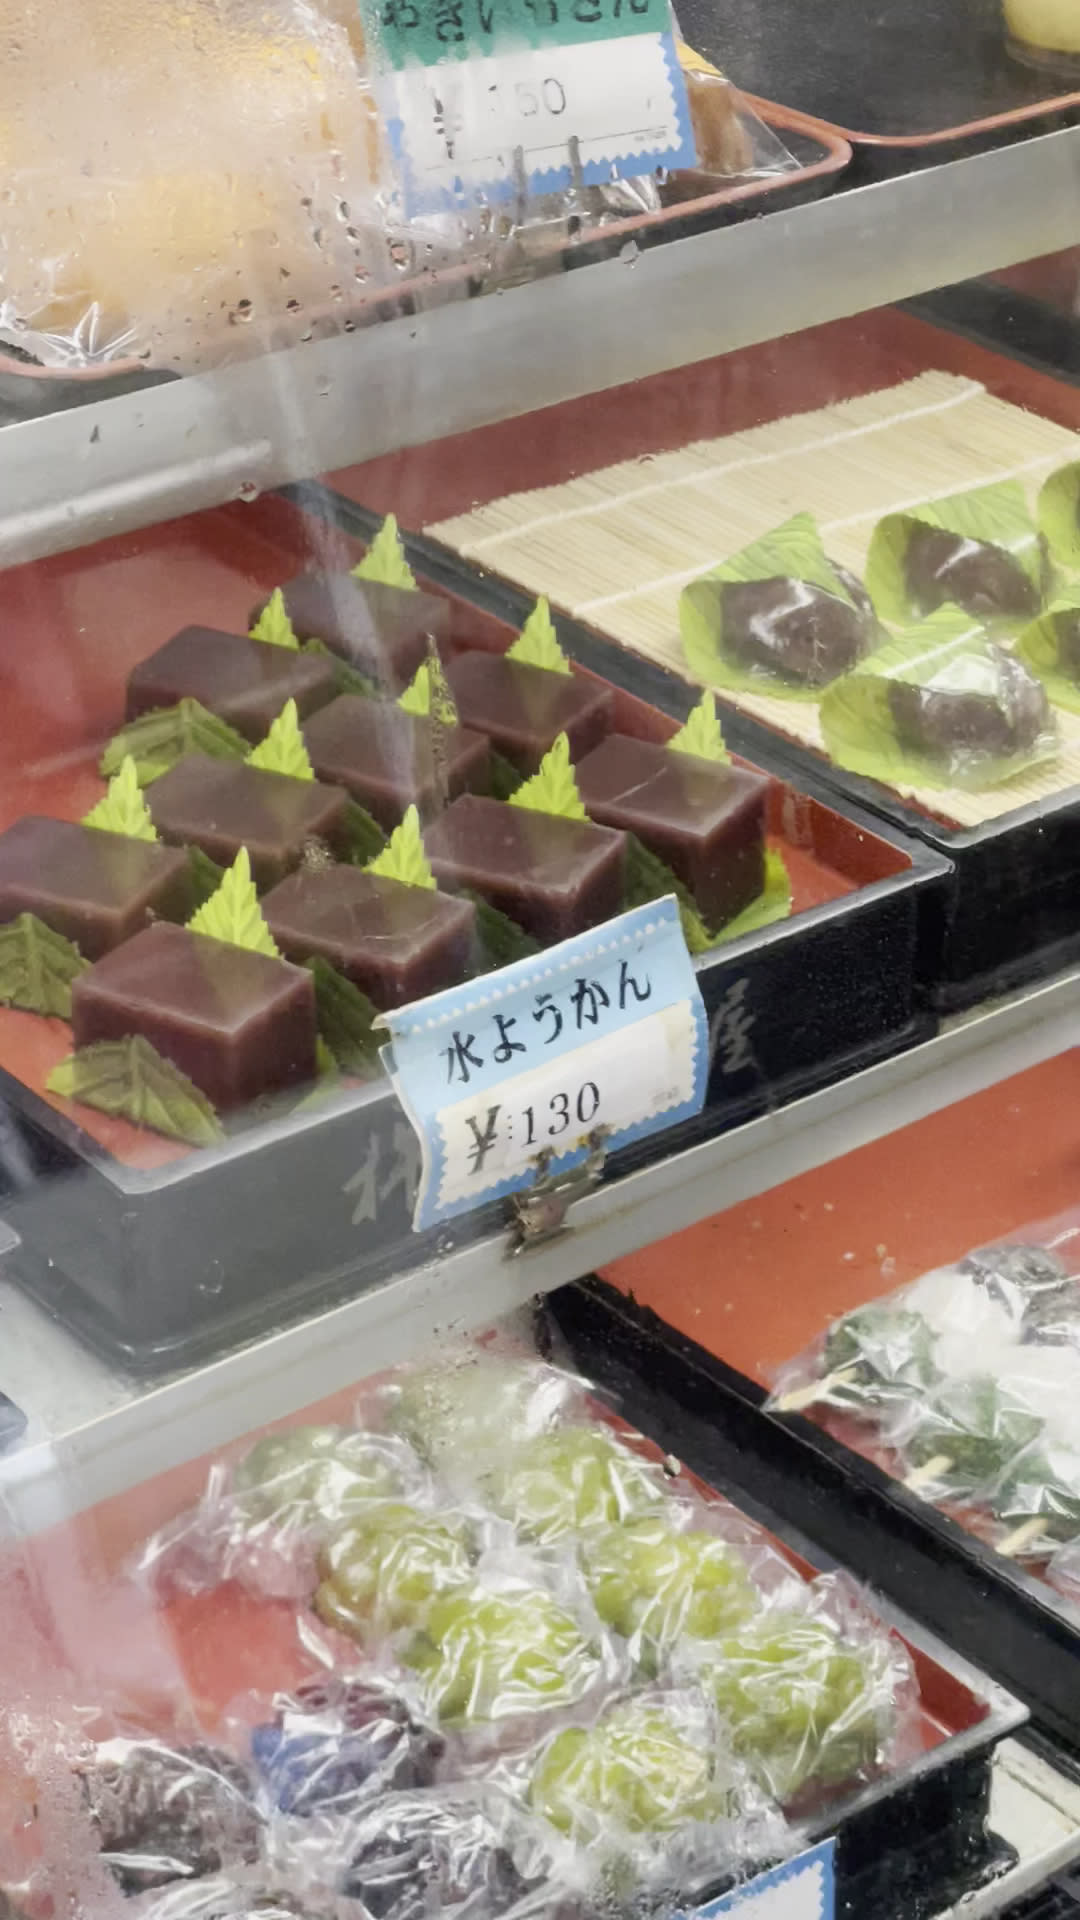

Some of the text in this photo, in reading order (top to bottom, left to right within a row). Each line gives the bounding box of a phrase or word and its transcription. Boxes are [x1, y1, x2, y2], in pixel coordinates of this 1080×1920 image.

[438, 959, 652, 1084] 水ようかん
[465, 1081, 601, 1176] ¥130
